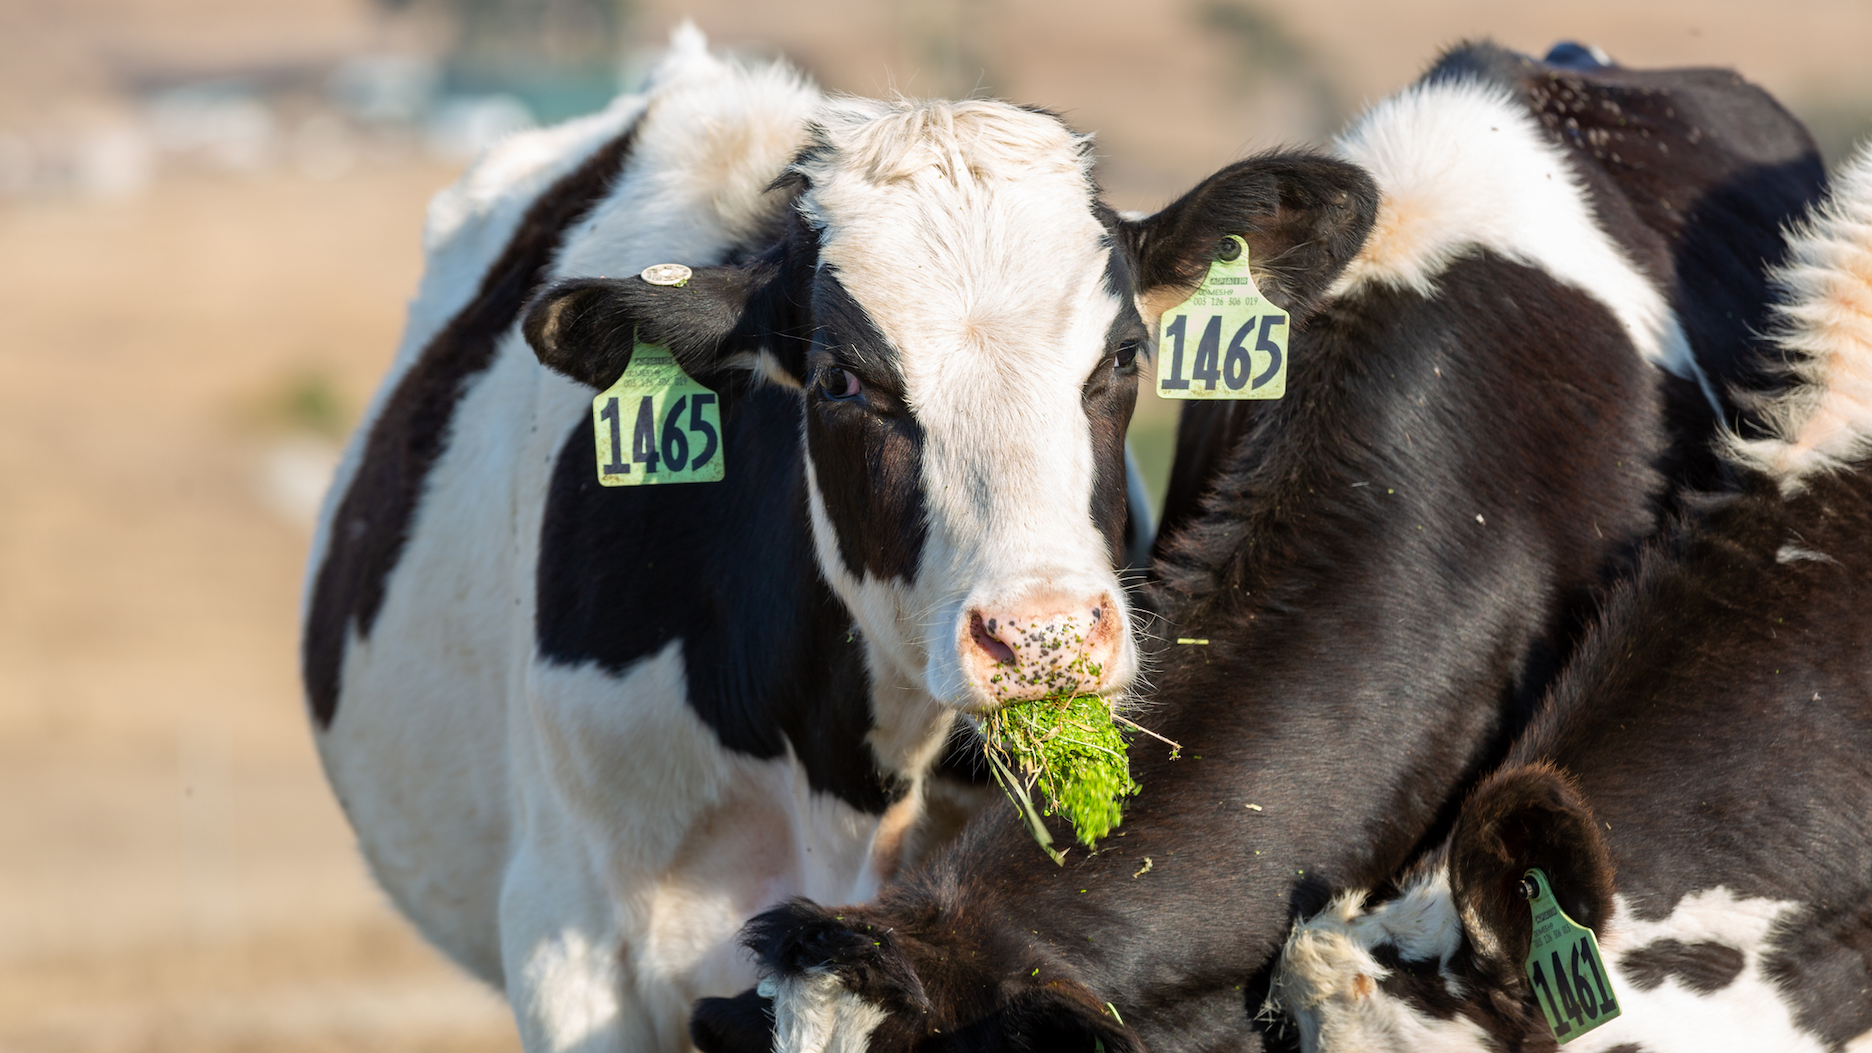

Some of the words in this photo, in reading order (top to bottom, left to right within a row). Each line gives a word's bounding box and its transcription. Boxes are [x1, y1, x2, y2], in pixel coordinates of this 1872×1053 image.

[1211, 297, 1224, 306] 126
[1228, 297, 1241, 306] 306
[1245, 297, 1259, 306] 019
[1161, 315, 1286, 390] 1465
[600, 393, 718, 475] 1465
[1532, 936, 1617, 1038] 1461
